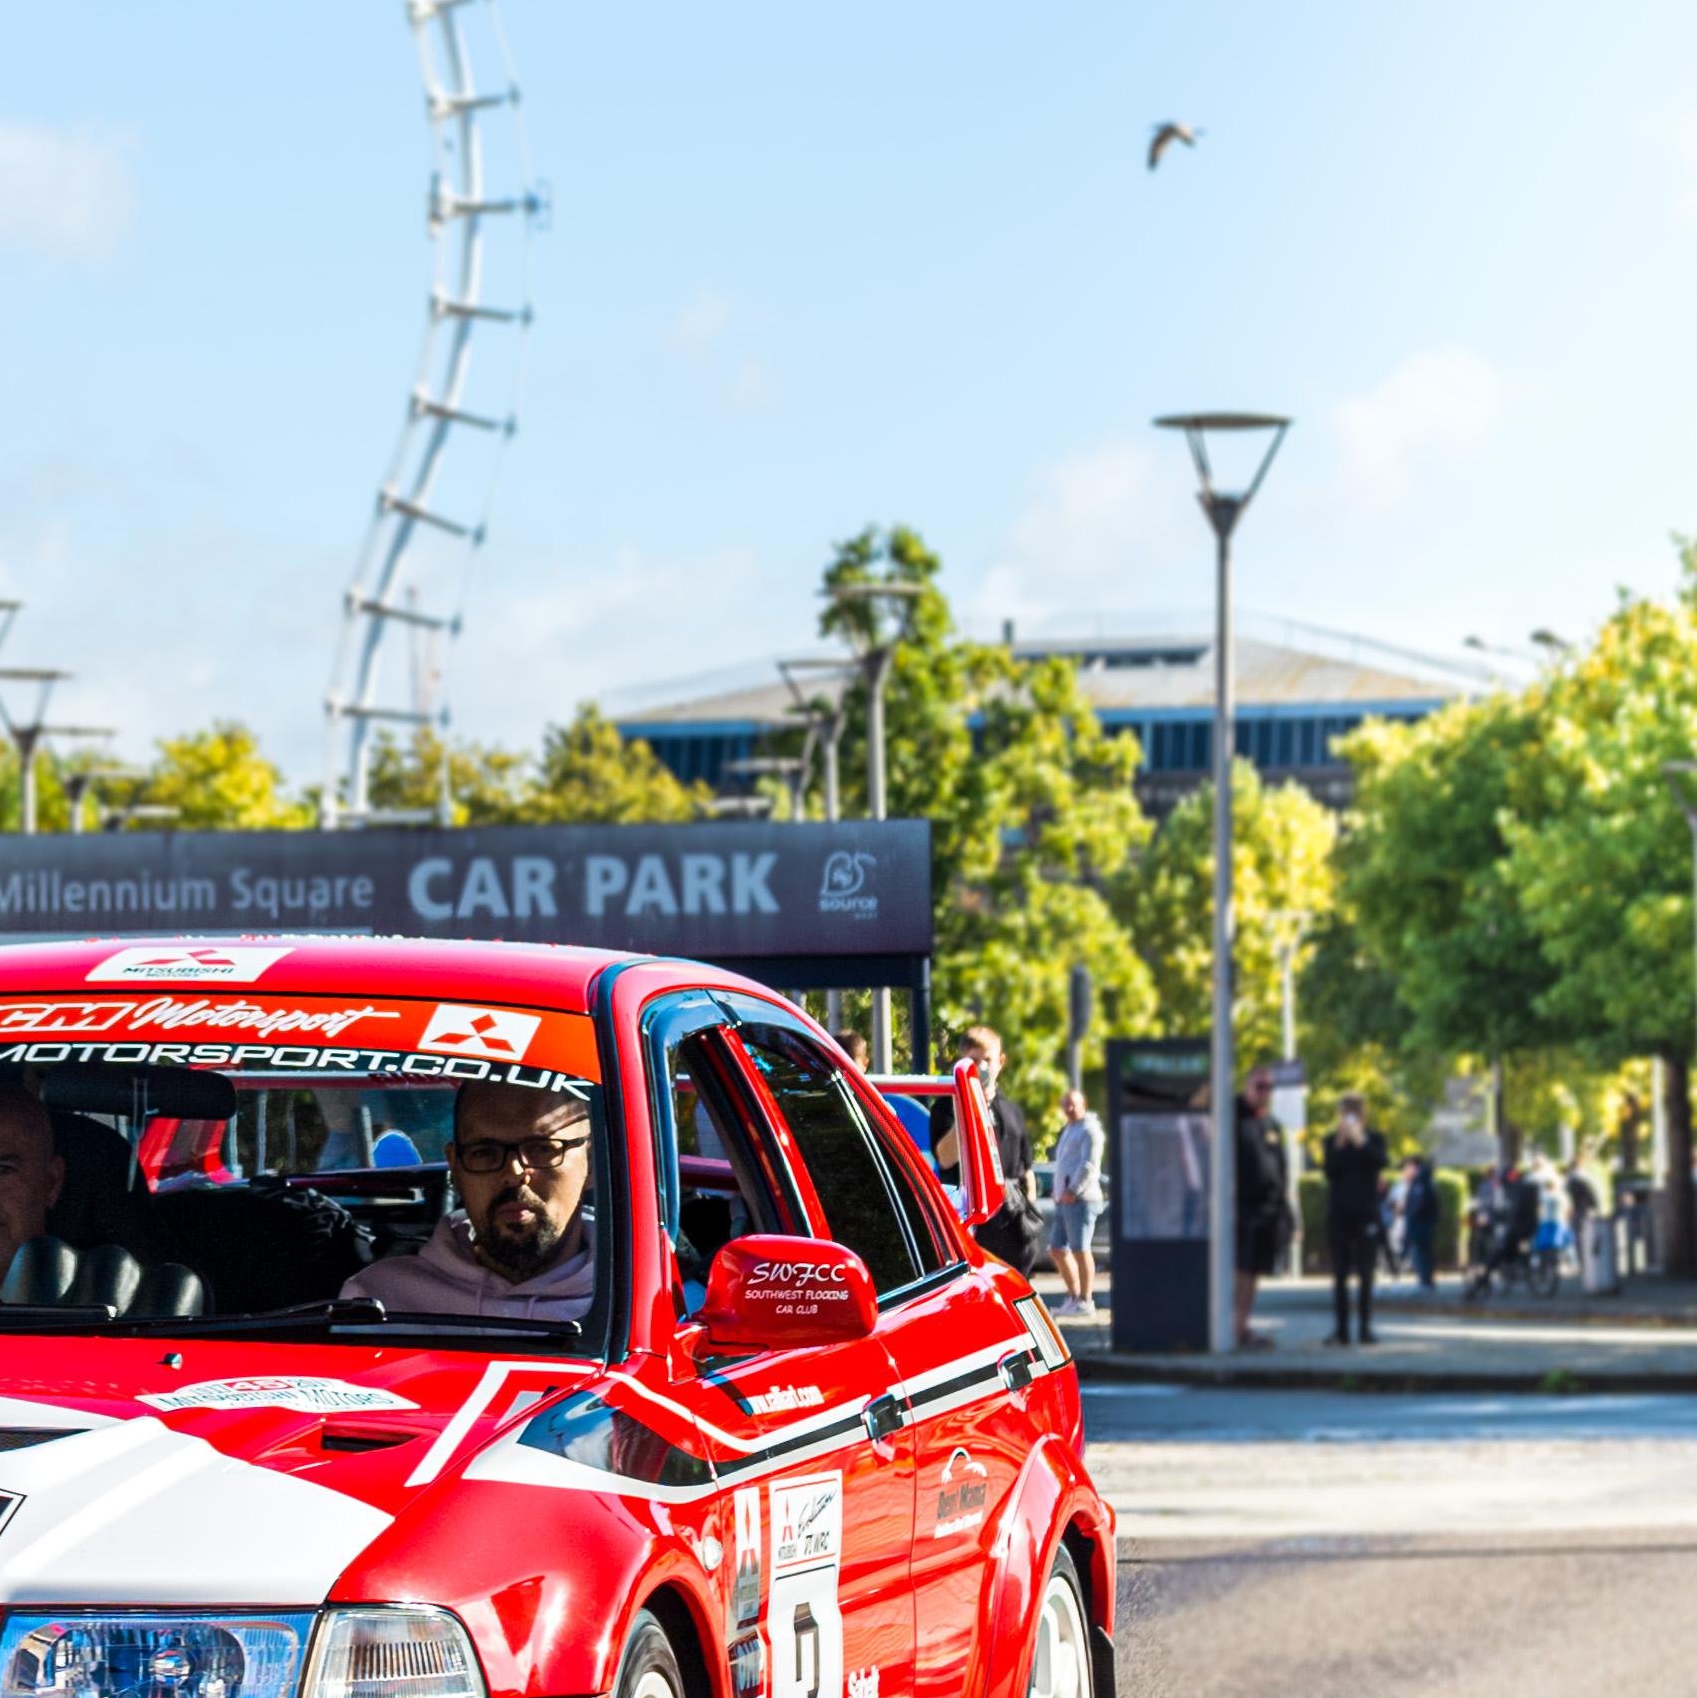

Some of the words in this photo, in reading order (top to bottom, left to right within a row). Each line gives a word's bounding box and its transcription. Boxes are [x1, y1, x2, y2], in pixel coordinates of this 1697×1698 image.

[230, 867, 374, 919] Square
[408, 857, 559, 919] CAR
[585, 852, 781, 916] PARK
[127, 997, 401, 1039] Motorsport
[744, 1289, 803, 1301] SOUTHWEST
[775, 1304, 793, 1315] CAR
[795, 1304, 819, 1315] CLUB
[299, 1388, 395, 1407] MOTORS
